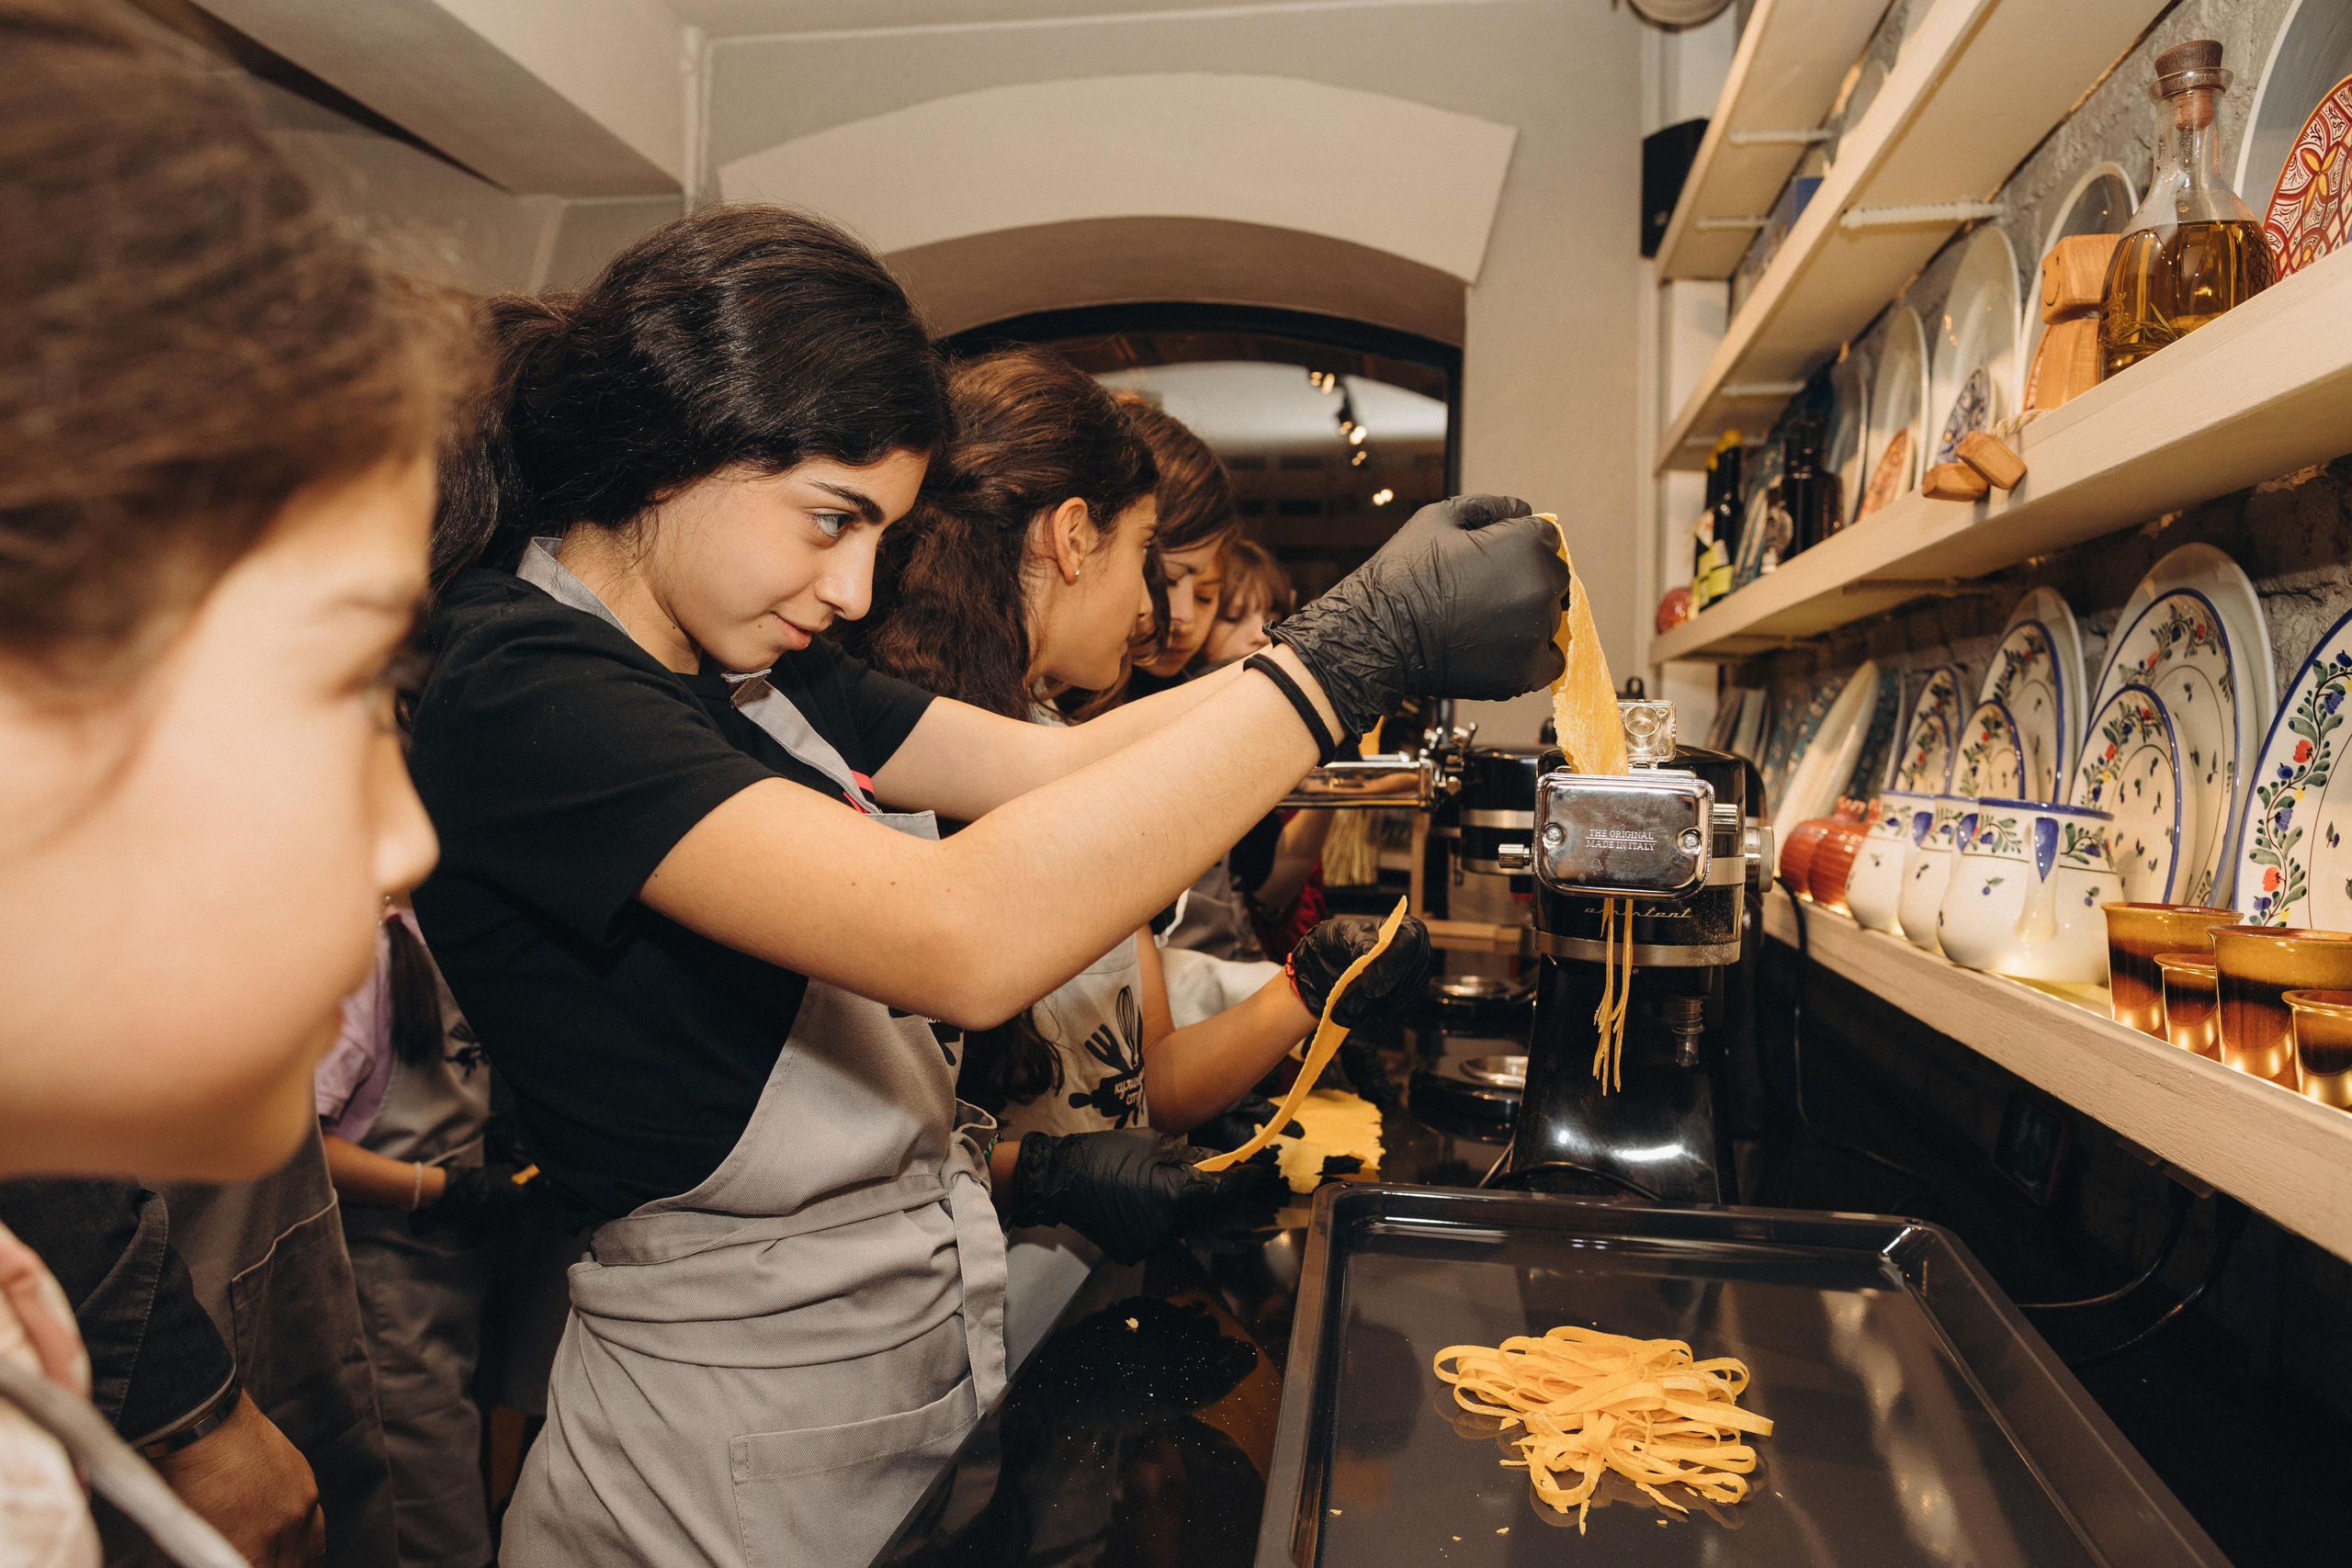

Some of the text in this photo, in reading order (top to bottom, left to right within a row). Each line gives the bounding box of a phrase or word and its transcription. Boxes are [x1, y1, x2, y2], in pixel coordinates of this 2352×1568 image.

[1589, 829, 1654, 840] THE ORIGINAL
[1586, 840, 1656, 851] MADE IN ITALY
